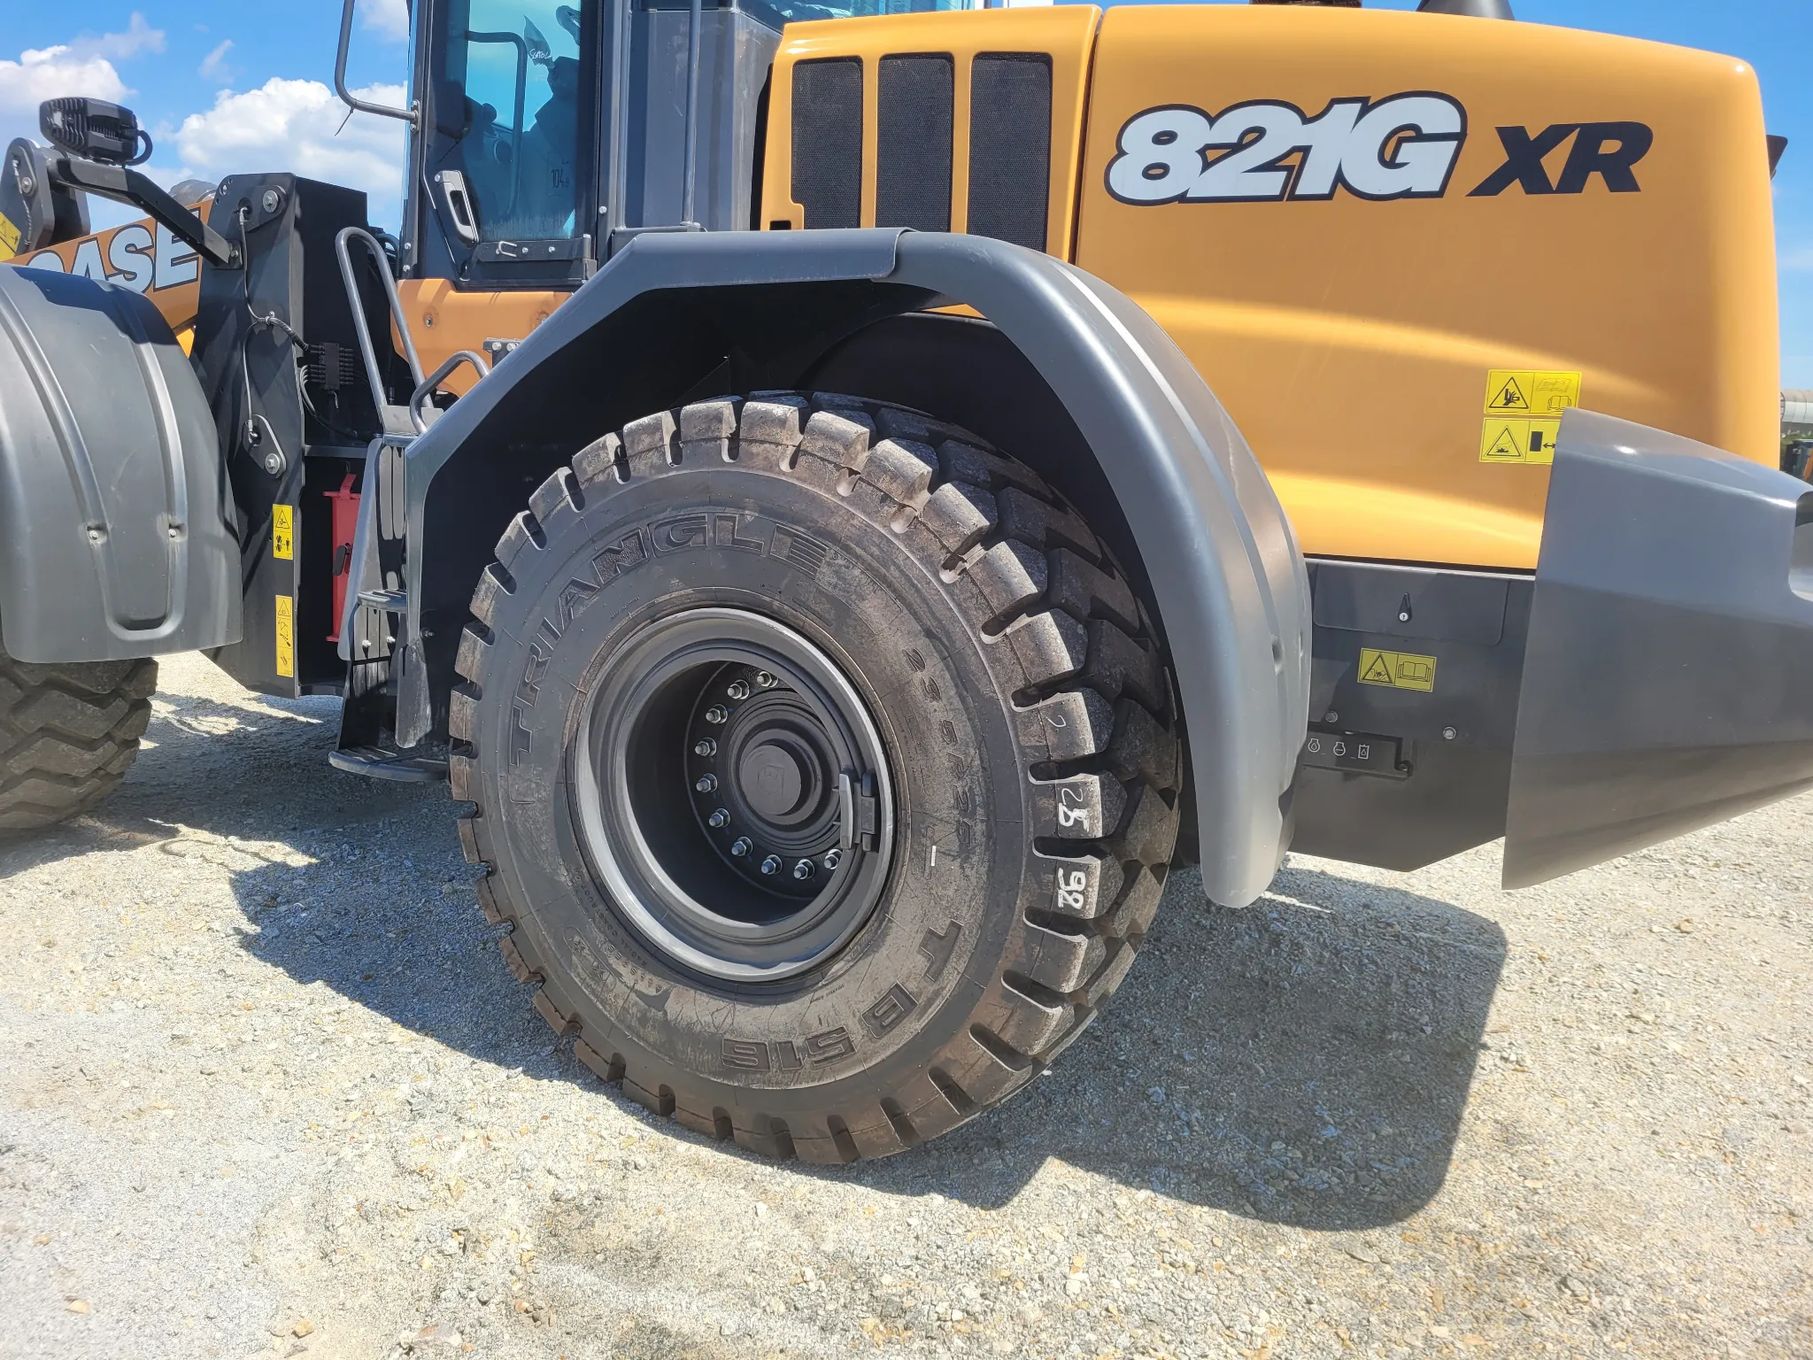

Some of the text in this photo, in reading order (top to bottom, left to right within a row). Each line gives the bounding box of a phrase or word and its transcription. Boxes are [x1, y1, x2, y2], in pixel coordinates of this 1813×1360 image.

[1104, 90, 1654, 206] 821G XR
[510, 513, 828, 767] TRIANGLE
